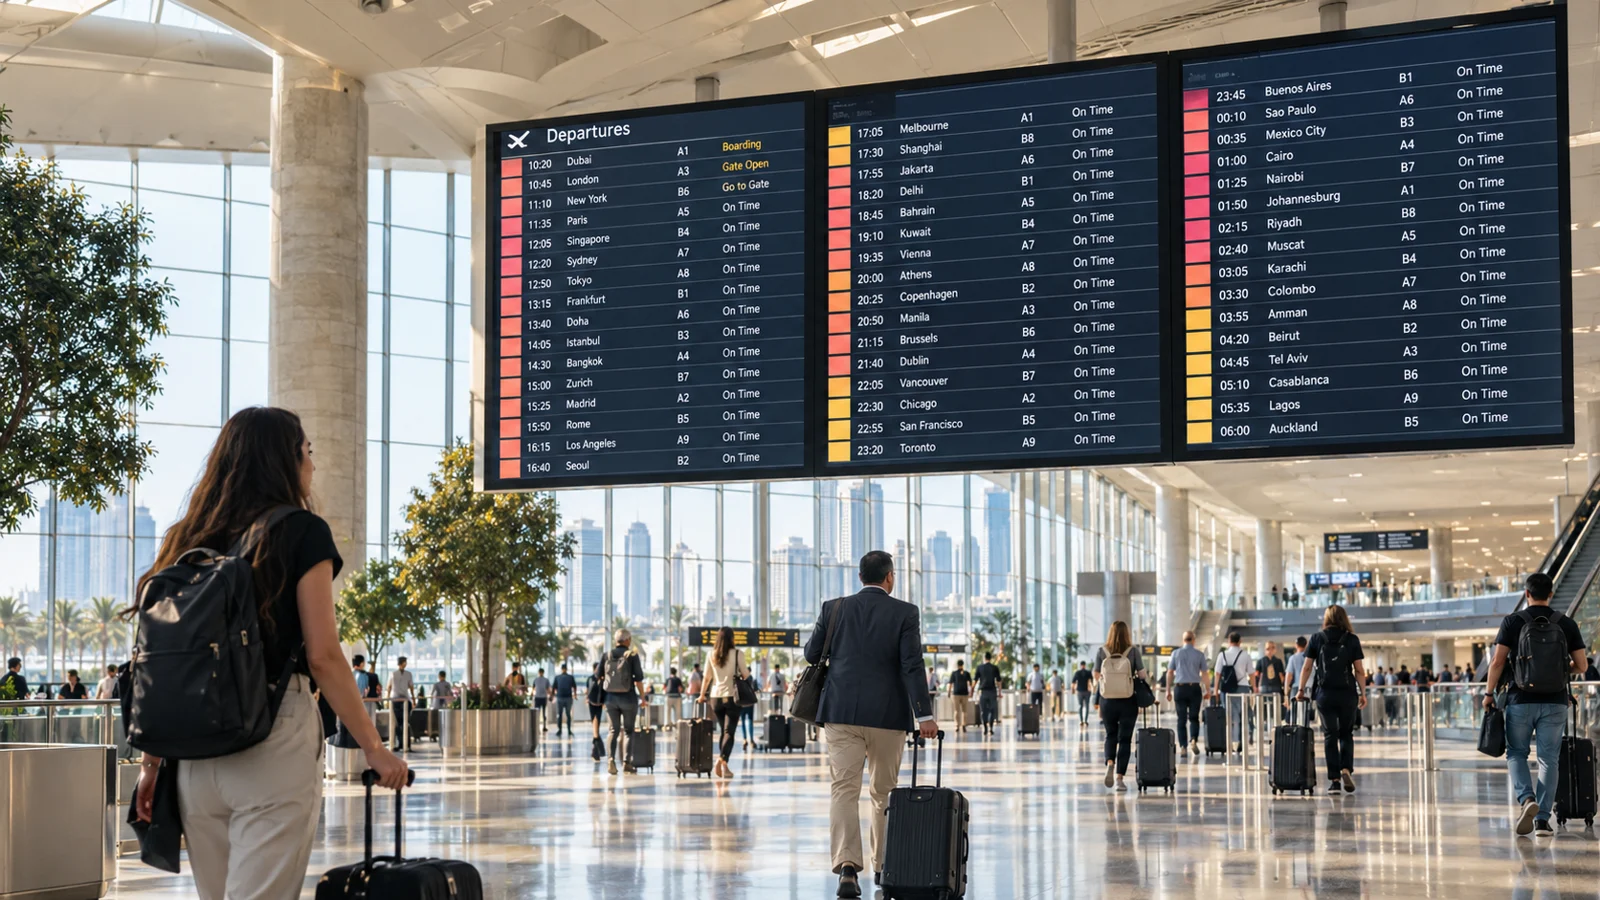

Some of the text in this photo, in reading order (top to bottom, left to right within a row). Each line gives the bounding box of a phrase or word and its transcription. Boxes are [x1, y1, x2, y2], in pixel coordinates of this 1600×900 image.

[1216, 71, 1412, 102] 23:45 Buenos Aires B1
[1216, 94, 1415, 124] 00:10 Sao Paulo A6
[547, 124, 631, 145] Departures
[858, 112, 1033, 139] 17:05 Melbourne A1
[1216, 116, 1415, 145] 00:35 Mexico City B3
[528, 139, 762, 170] 10:20 Dubai A1 Boarding
[858, 132, 1035, 159] 17:30 Shanghai B8
[1217, 138, 1415, 167] 01:00 Cairo A4
[528, 159, 769, 190] 10:45 London A3 Gate Open
[858, 154, 1035, 180] 17:55 Jakarta A6
[1217, 161, 1415, 189] 01:25 Nairobi B7
[528, 179, 770, 210] 11:10 New York B6 Go to Gate
[858, 175, 1033, 201] 18:20 Delhi B1
[1217, 184, 1414, 212] 01:50 Johannesburg A1
[528, 206, 690, 230] 11:35 Paris A5
[858, 196, 1035, 221] 18:45 Bahrain A5
[1218, 206, 1416, 234] 02:15 Riyadh B8
[528, 227, 690, 250] 12:05 Singapore B4
[858, 218, 1035, 242] 19:10 Kuwait B4
[528, 247, 690, 270] 12:20 Sydney A7
[858, 239, 1035, 263] 19:35 Vienna A7
[1218, 239, 1305, 256] 02:40 Muscat
[857, 261, 1036, 284] 20:00 Athens A8
[1218, 252, 1417, 278] 03:05 Karachi B4
[528, 267, 690, 290] 12:50 Tokyo A8
[1219, 275, 1417, 301] 03:30 Colombo A7
[528, 288, 689, 310] 13:15 Frankfurt B1
[857, 282, 1035, 306] 20:25 Copenhagen B2
[528, 309, 690, 330] 13:40 Doha A6
[857, 312, 930, 327] 20:50 Manila
[1219, 308, 1308, 323] 03:55 Amman
[528, 330, 690, 350] 14:05 Istanbul B3
[857, 326, 1036, 348] 21:15 Brussels B6
[1219, 322, 1418, 346] 04:20 Beirut B2
[527, 356, 603, 371] 14:30 Bangkok
[857, 348, 1036, 370] 21:40 Dublin A4
[1219, 345, 1418, 368] 04:45 Tel Aviv A3
[527, 371, 690, 391] 15:00 Zurich B7
[857, 370, 1036, 391] 22:05 Vancouver B7
[1220, 375, 1330, 391] 05:10 Casablanca
[527, 397, 596, 411] 15:25 Madrid
[857, 399, 938, 413] 22:30 Chicago
[1220, 392, 1419, 414] 05:35 Lagos A9
[527, 413, 690, 432] 15:50 Rome B5
[857, 414, 1036, 434] 22:55 San Francisco B5
[1220, 416, 1419, 437] 06:00 Auckland B5
[527, 438, 617, 453] 16:15 Los Angeles
[857, 436, 1036, 456] 23:20 Toronto A9
[527, 455, 690, 473] 16:40 Seoul B2
